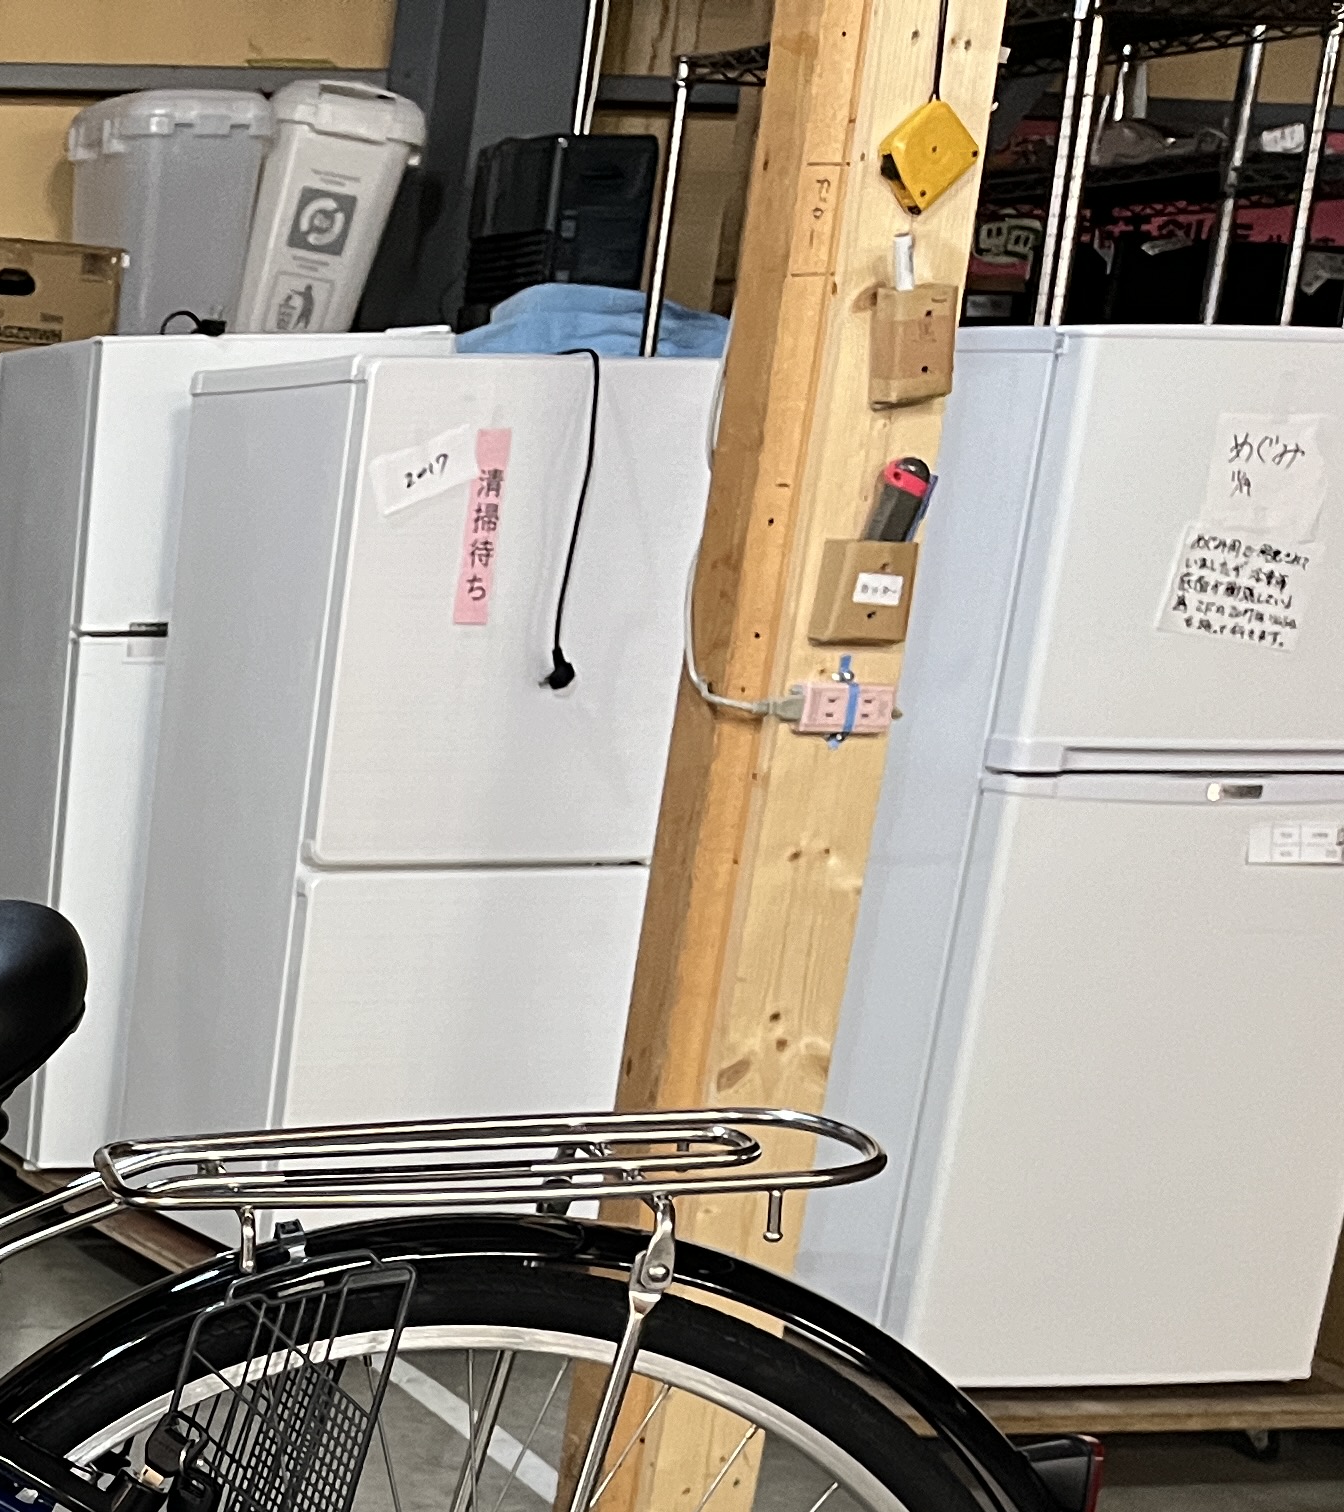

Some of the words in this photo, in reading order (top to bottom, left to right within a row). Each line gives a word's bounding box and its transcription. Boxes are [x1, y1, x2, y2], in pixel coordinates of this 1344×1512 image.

[1228, 432, 1306, 469] めぐみ
[466, 468, 506, 602] 清掃待ち
